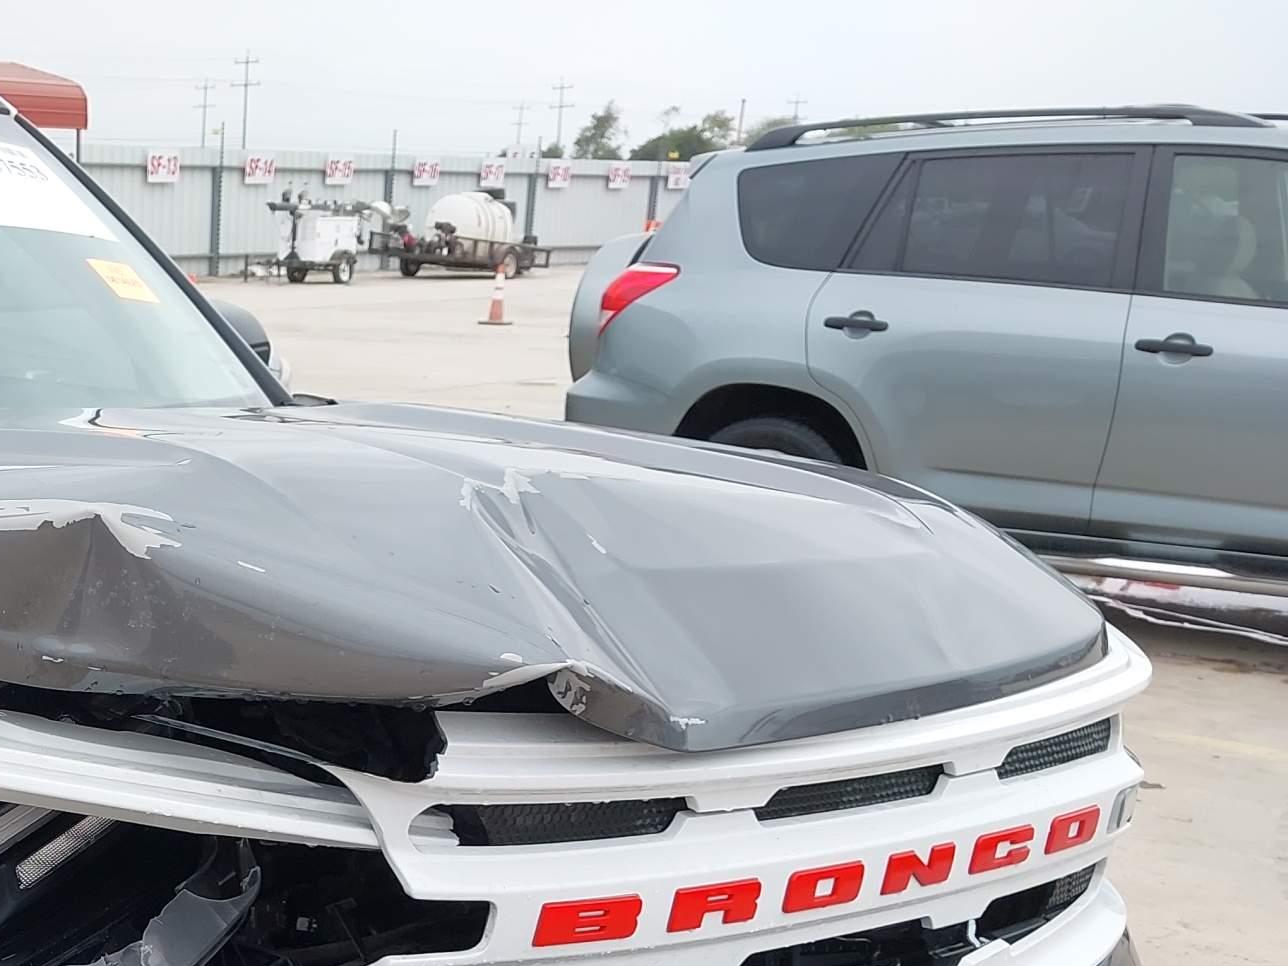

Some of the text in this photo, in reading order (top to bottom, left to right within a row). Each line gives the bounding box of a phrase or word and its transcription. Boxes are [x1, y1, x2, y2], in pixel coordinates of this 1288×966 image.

[150, 154, 179, 176] SF-13
[247, 157, 276, 178] SF-14
[326, 158, 354, 178] SF-15
[531, 803, 1102, 948] BRONCO
